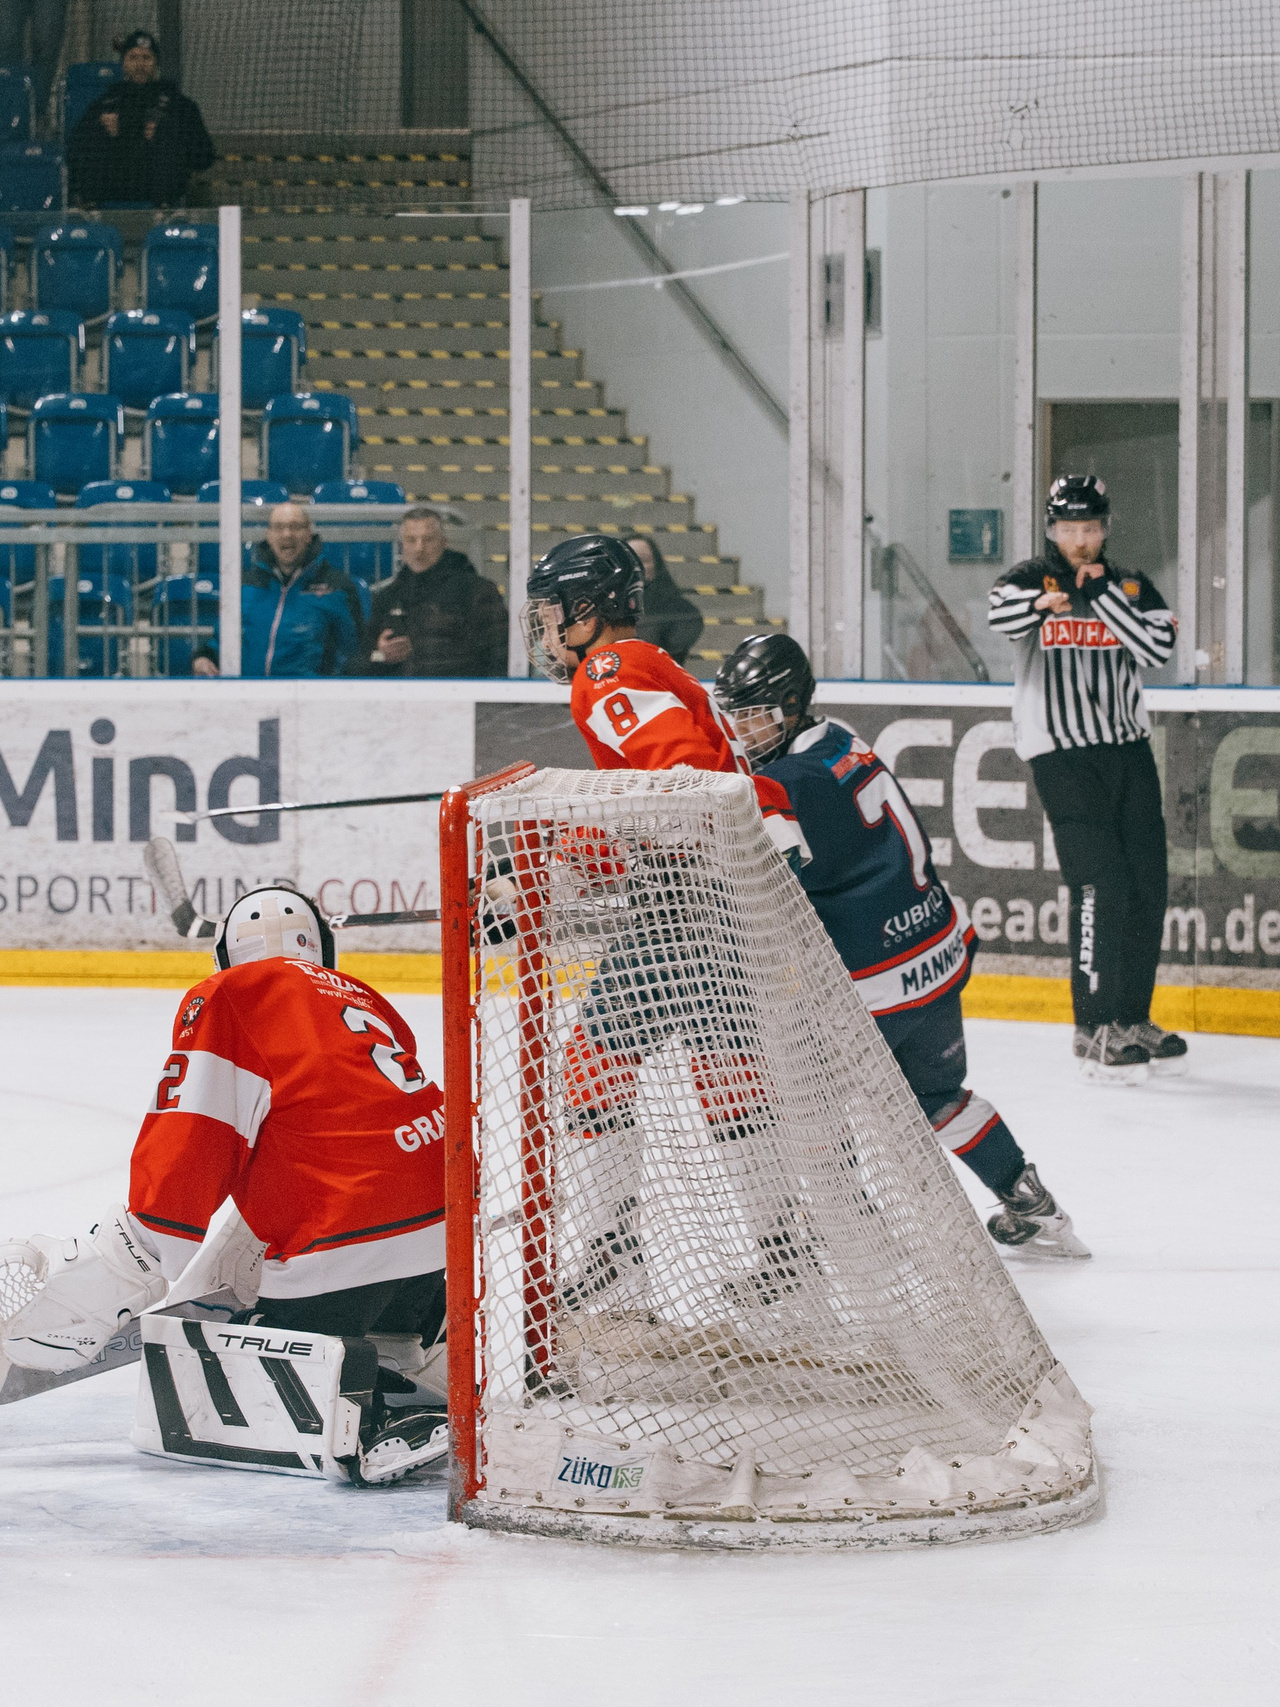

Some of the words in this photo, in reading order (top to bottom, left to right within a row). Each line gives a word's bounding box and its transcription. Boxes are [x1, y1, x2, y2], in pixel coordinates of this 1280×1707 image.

[603, 692, 640, 736] 8
[156, 1053, 189, 1111] 2
[114, 1218, 152, 1273] TRUE
[216, 1333, 314, 1357] TRUE
